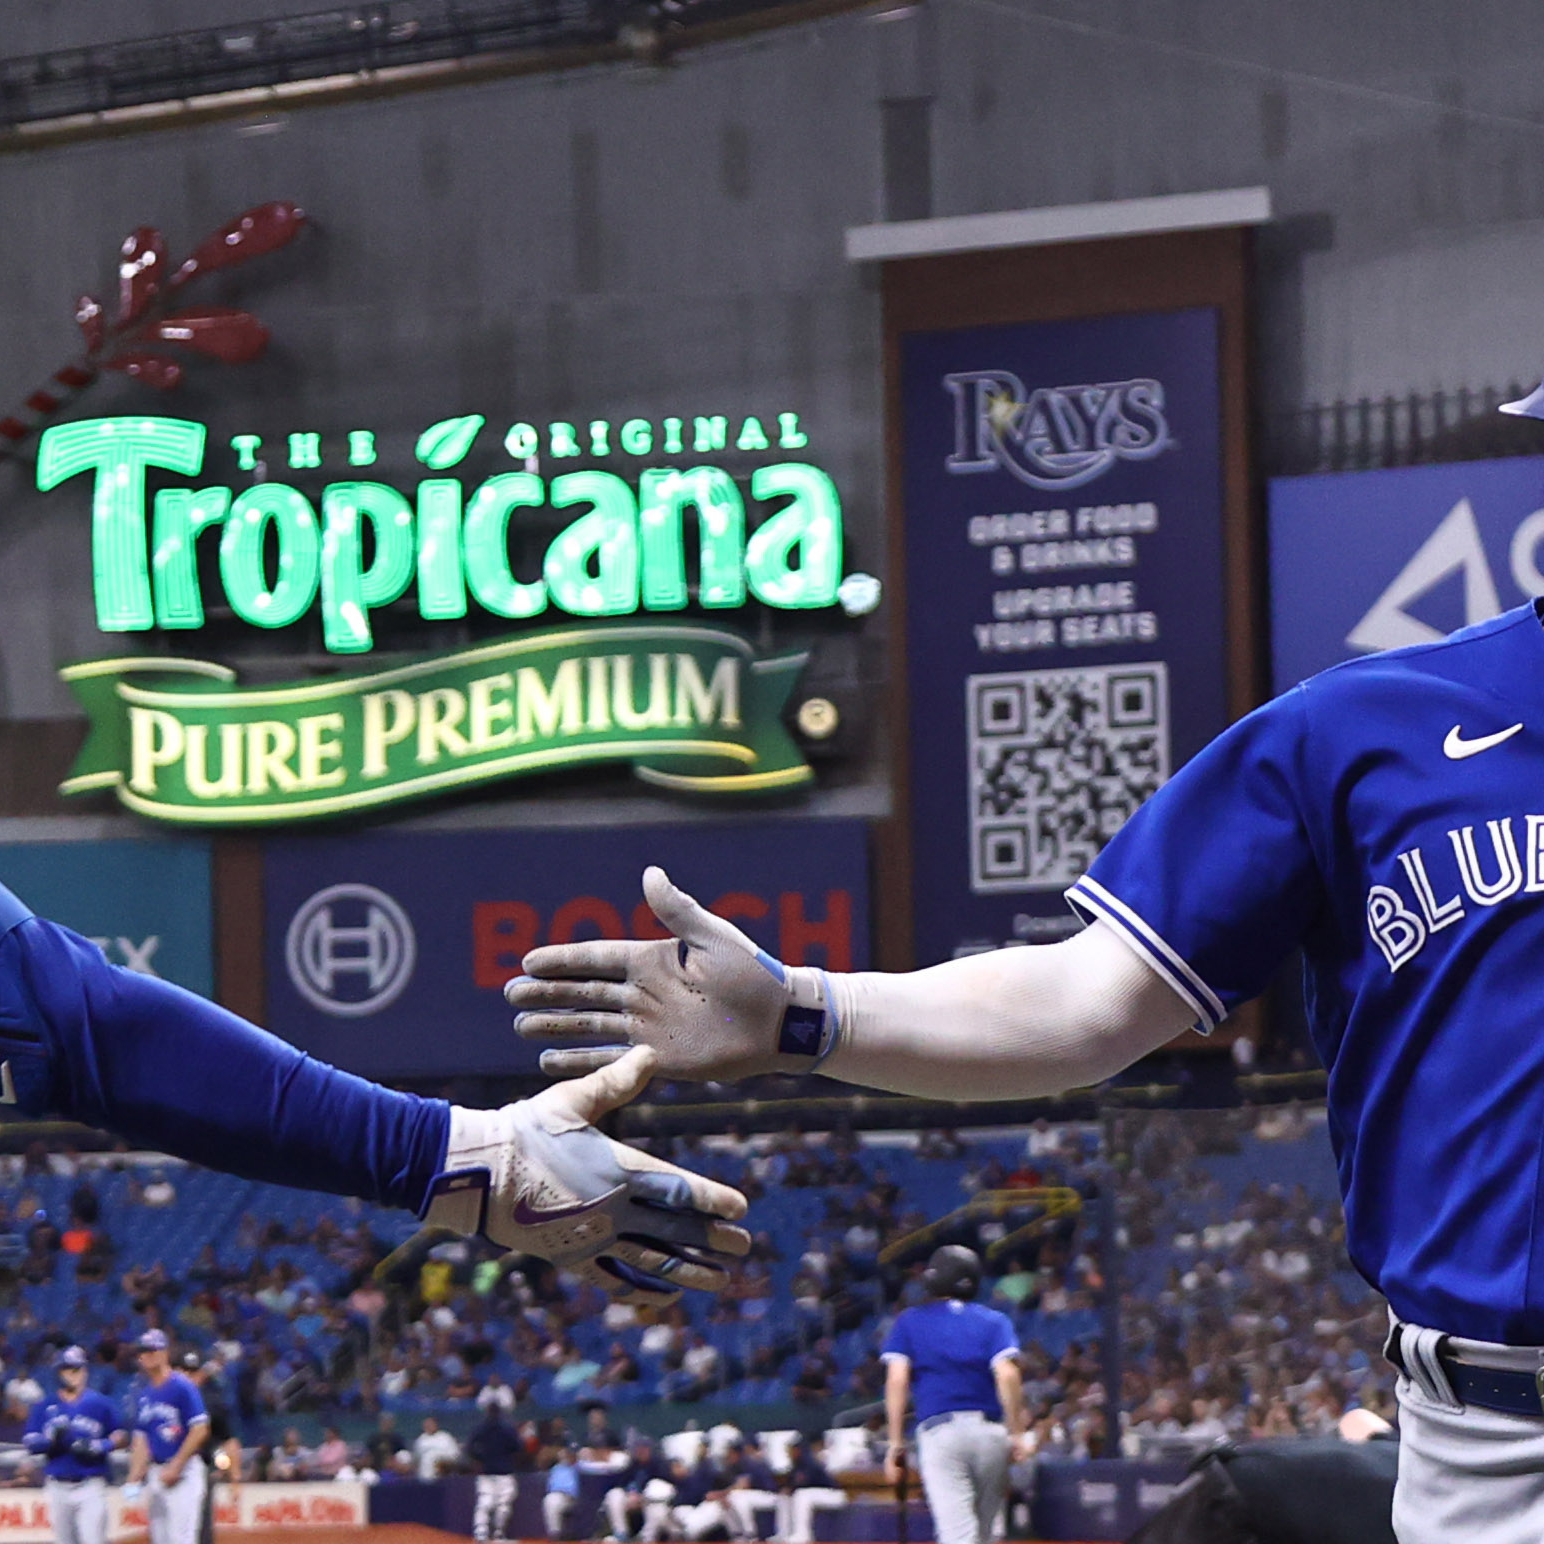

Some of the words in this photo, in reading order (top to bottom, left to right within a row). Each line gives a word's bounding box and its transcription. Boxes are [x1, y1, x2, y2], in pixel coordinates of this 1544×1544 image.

[231, 430, 378, 470] THE
[504, 412, 809, 459] ORIGINAL
[968, 508, 1070, 546] ORDER
[1075, 502, 1158, 536] FOOD
[1019, 535, 1137, 574] DRINKS
[992, 580, 1137, 620] UPGRADE
[973, 618, 1055, 653] YOUR
[1060, 611, 1158, 647] SEATS
[129, 706, 347, 798] PURE
[360, 653, 743, 779] PREMIUM
[472, 889, 853, 989] BOH
